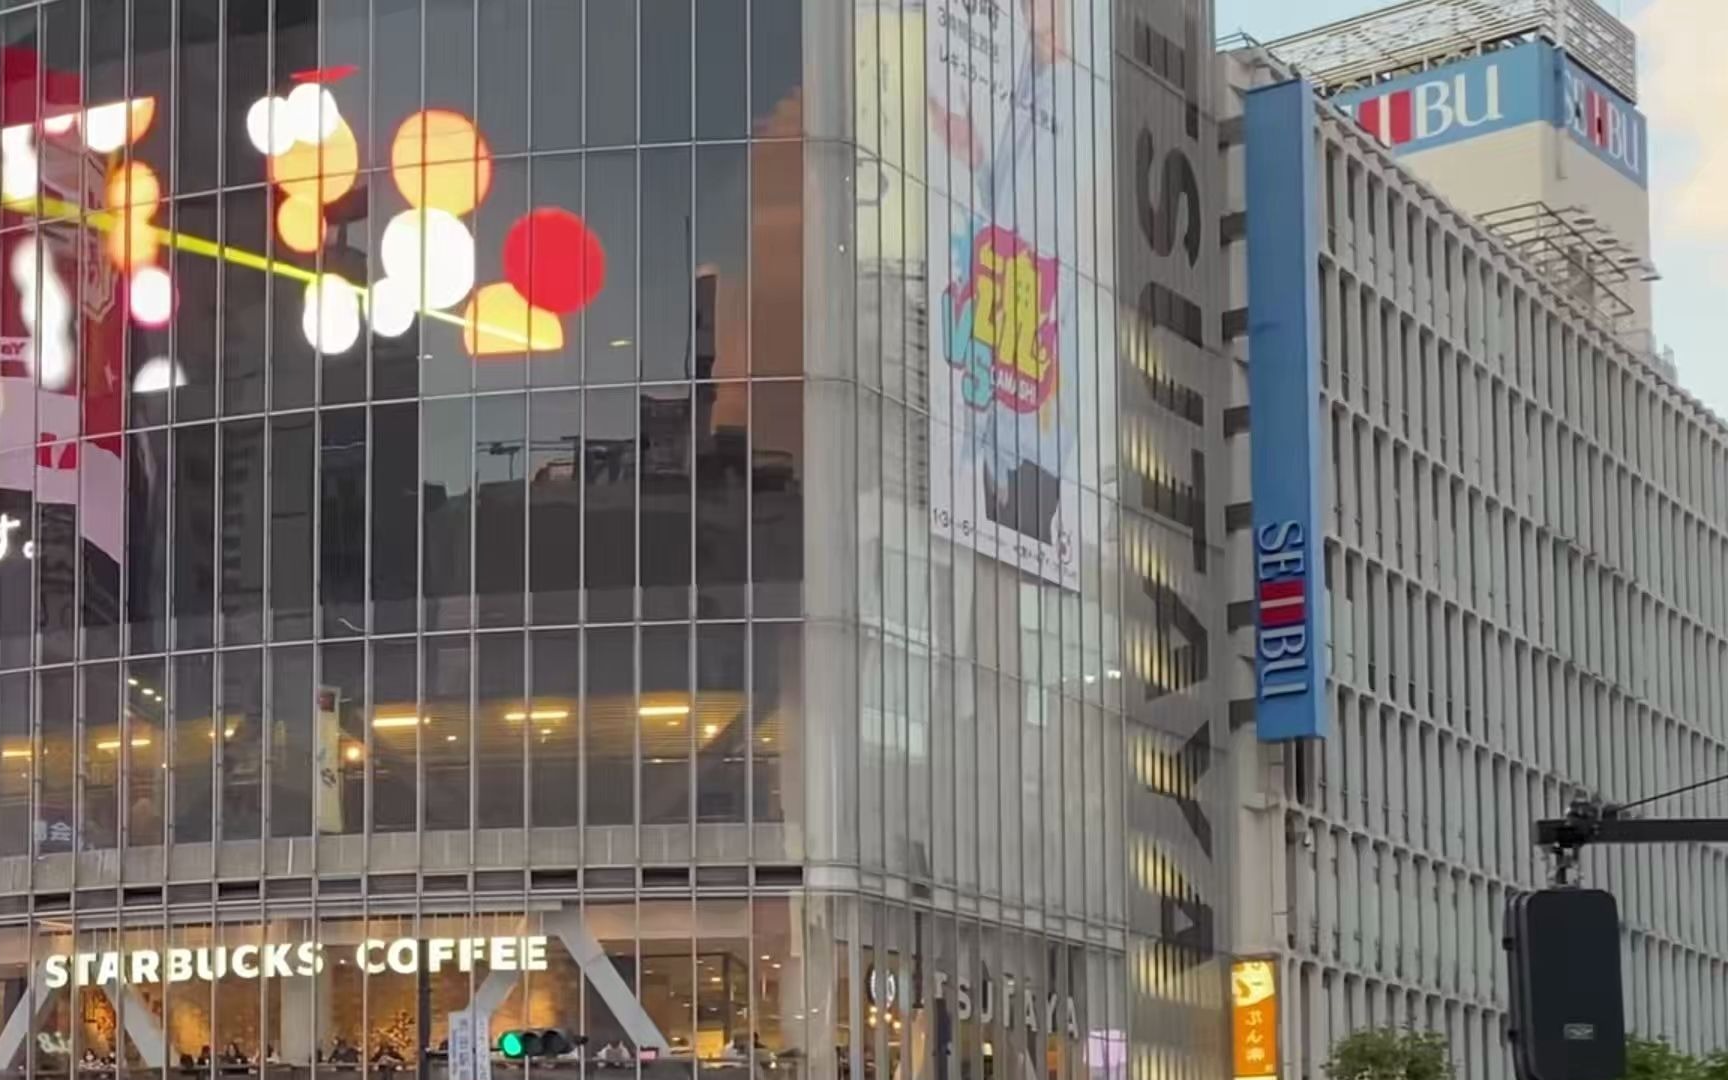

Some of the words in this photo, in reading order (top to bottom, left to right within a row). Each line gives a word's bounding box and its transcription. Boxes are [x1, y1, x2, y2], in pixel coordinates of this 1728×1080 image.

[1563, 69, 1642, 173] SEIBU
[1257, 519, 1307, 700] SEIBU
[45, 941, 324, 989] STARBUCKS
[356, 935, 549, 974] COFFEE
